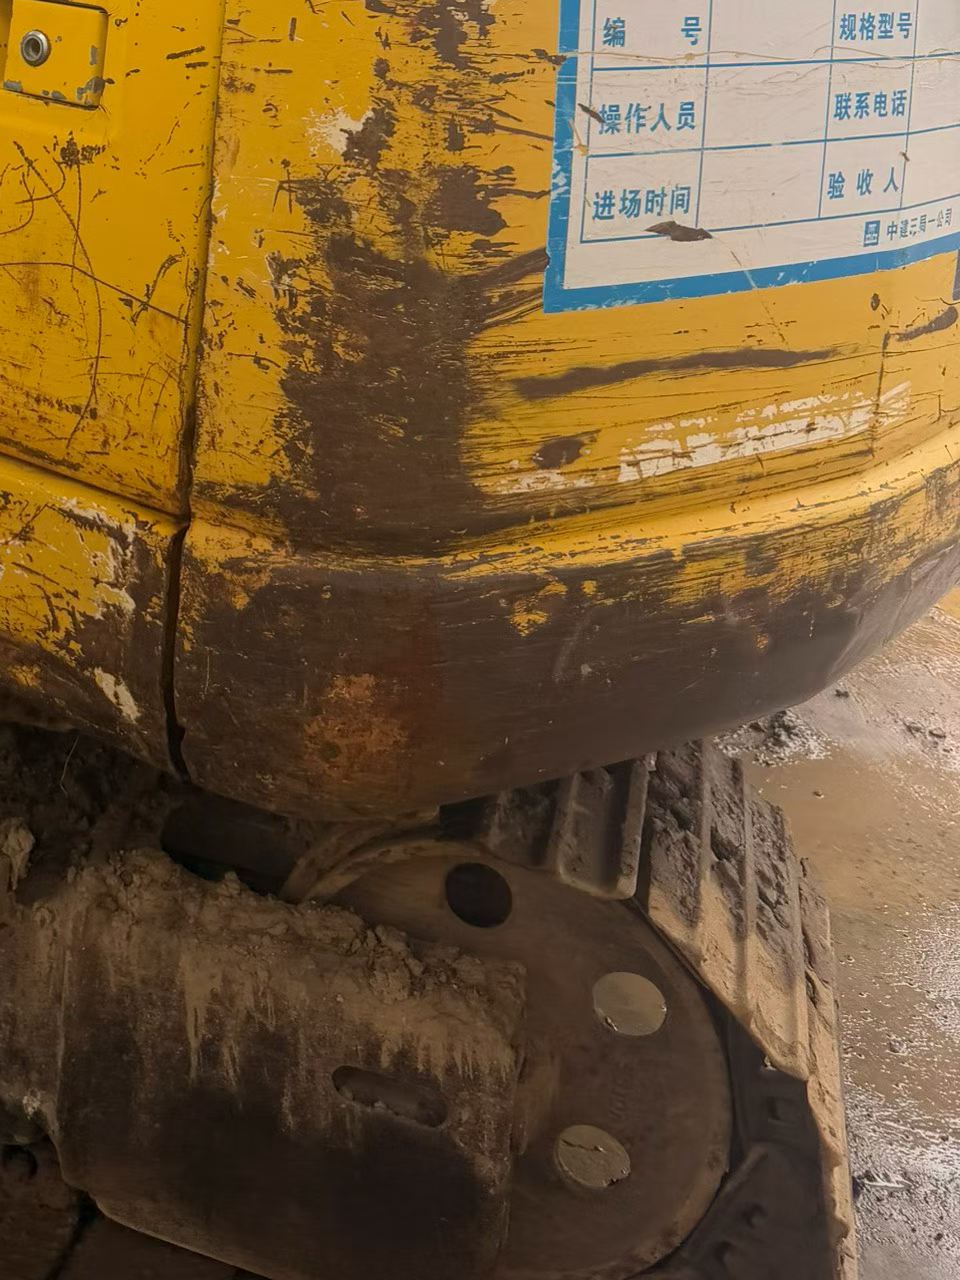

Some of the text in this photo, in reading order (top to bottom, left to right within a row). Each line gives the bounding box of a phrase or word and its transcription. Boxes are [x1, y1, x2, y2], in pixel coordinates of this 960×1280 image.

[839, 11, 914, 41] 规格型号
[598, 100, 697, 135] 操作人员
[833, 88, 908, 121] 联系电话
[827, 168, 899, 200] 验收人
[591, 185, 692, 221] 进场时间
